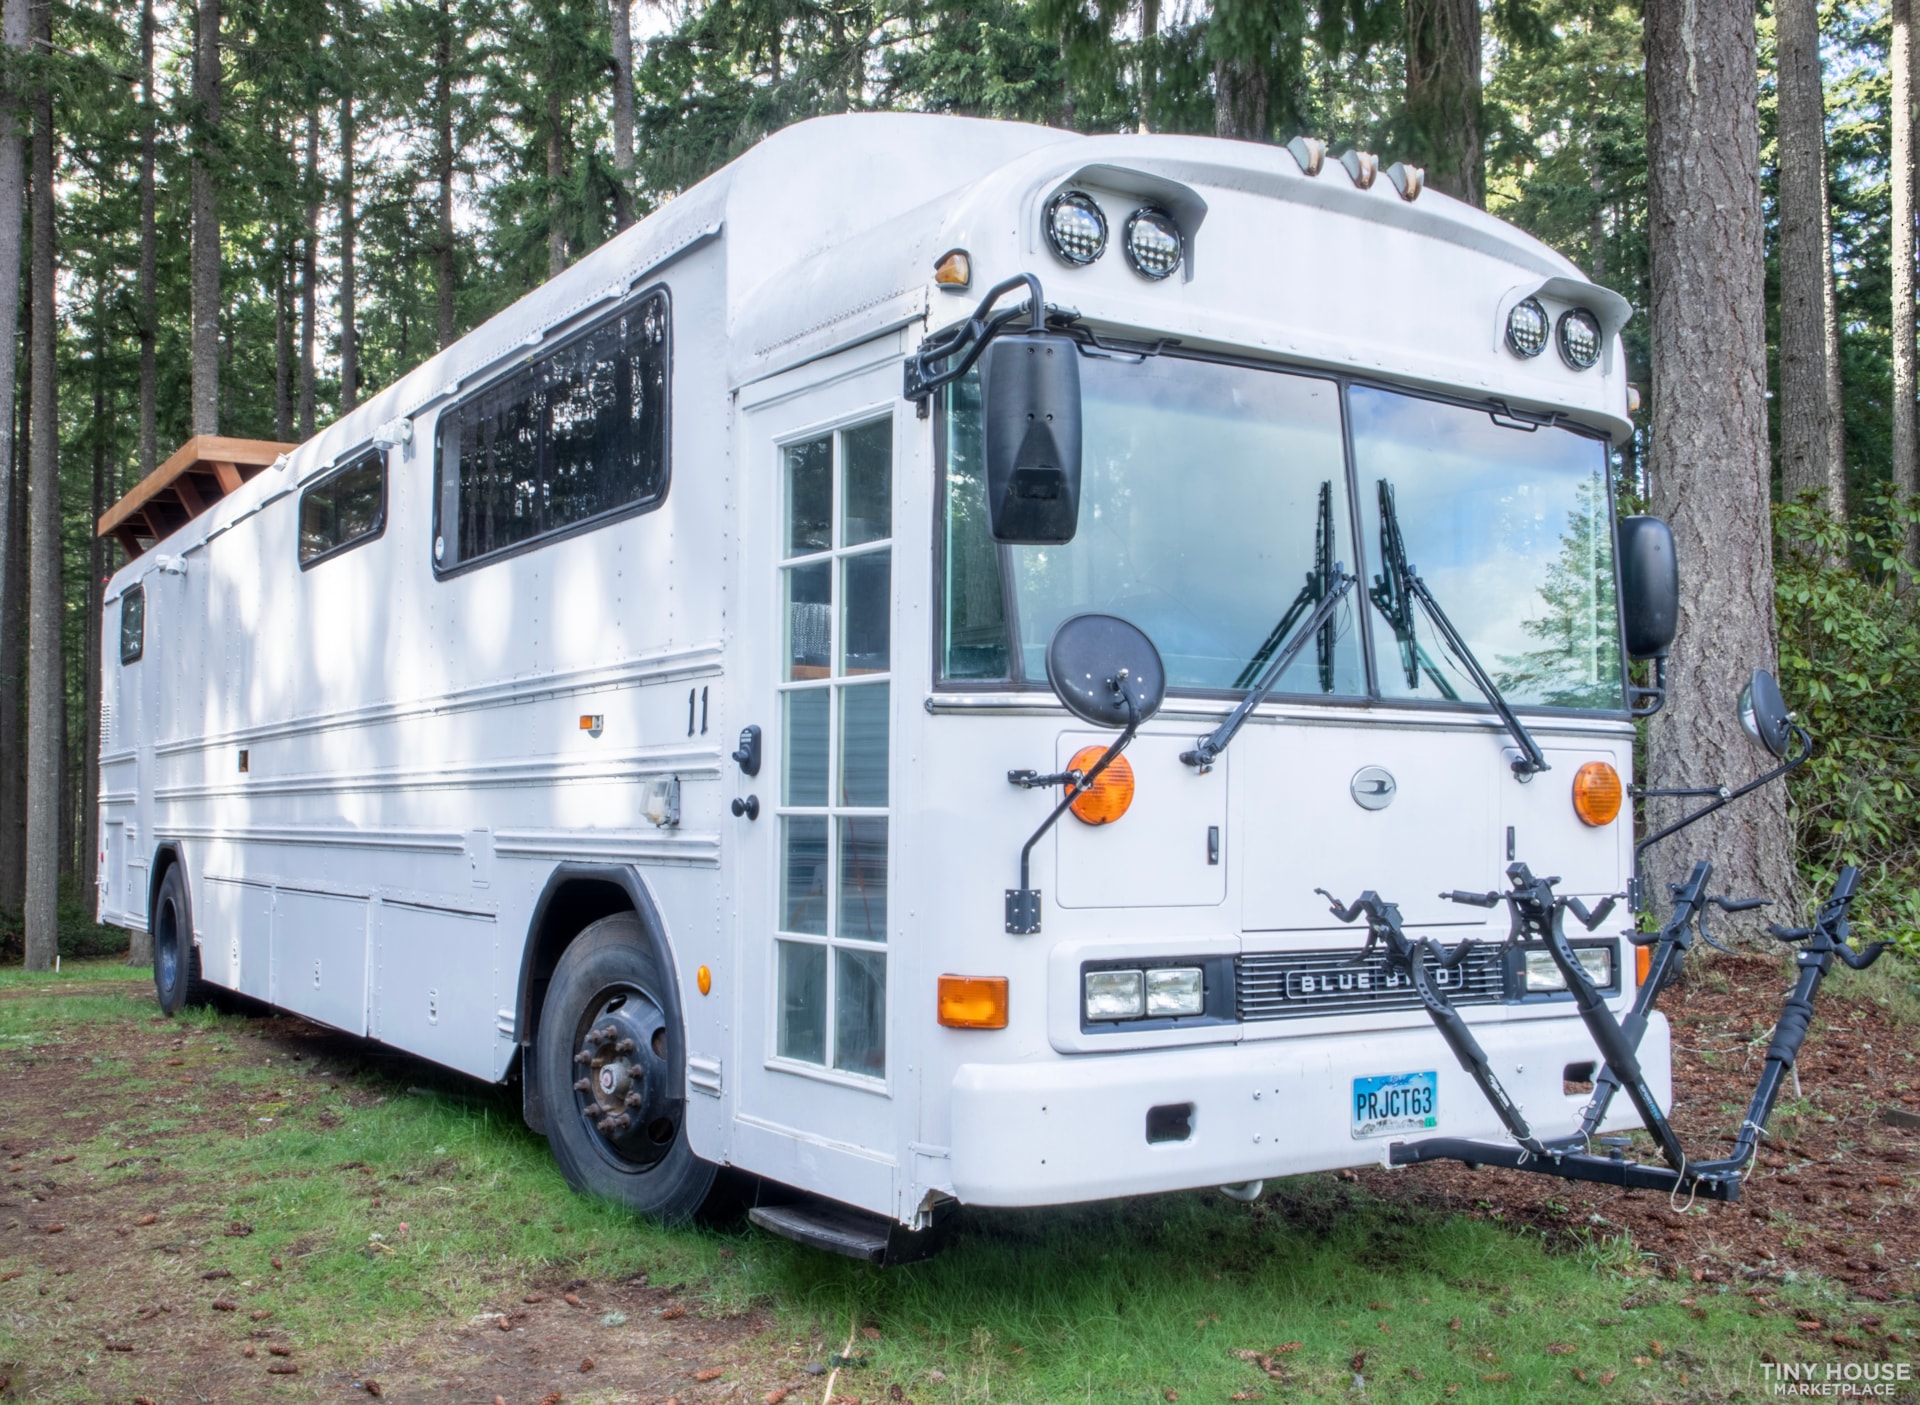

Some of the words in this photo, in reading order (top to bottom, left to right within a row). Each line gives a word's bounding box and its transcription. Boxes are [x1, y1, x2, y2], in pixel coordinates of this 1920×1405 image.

[1301, 973, 1370, 992] BLUE
[1386, 969, 1448, 987] BID
[1357, 1087, 1432, 1121] PRJCT63
